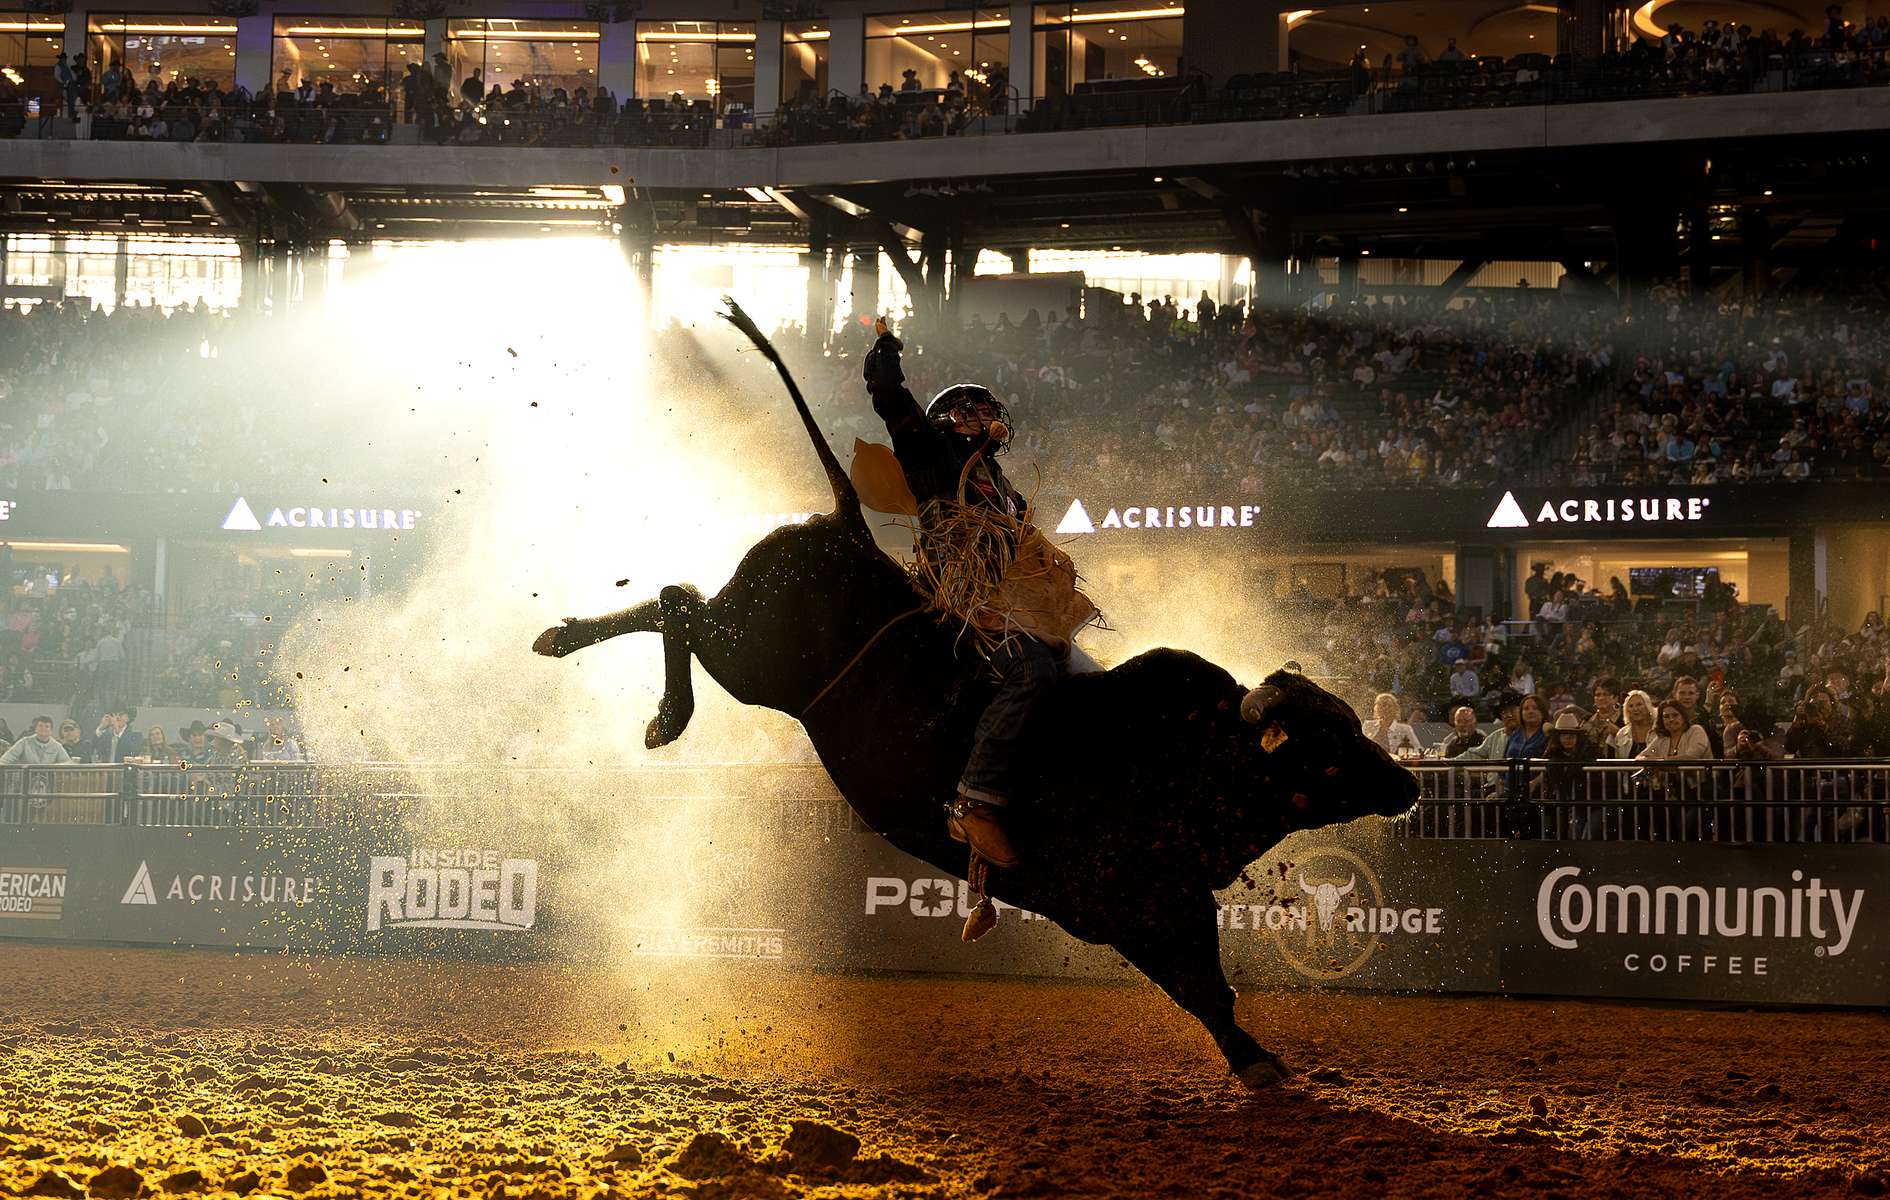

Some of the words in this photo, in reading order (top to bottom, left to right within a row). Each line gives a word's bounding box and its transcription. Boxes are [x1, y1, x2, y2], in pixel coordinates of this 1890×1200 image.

[411, 848, 501, 870] INSIDE
[166, 873, 315, 904] ACRISURE
[367, 855, 538, 932] RODEO
[1216, 903, 1307, 932] TETON
[1346, 907, 1443, 935] RIDGE
[1623, 953, 1768, 976] COFFEE
